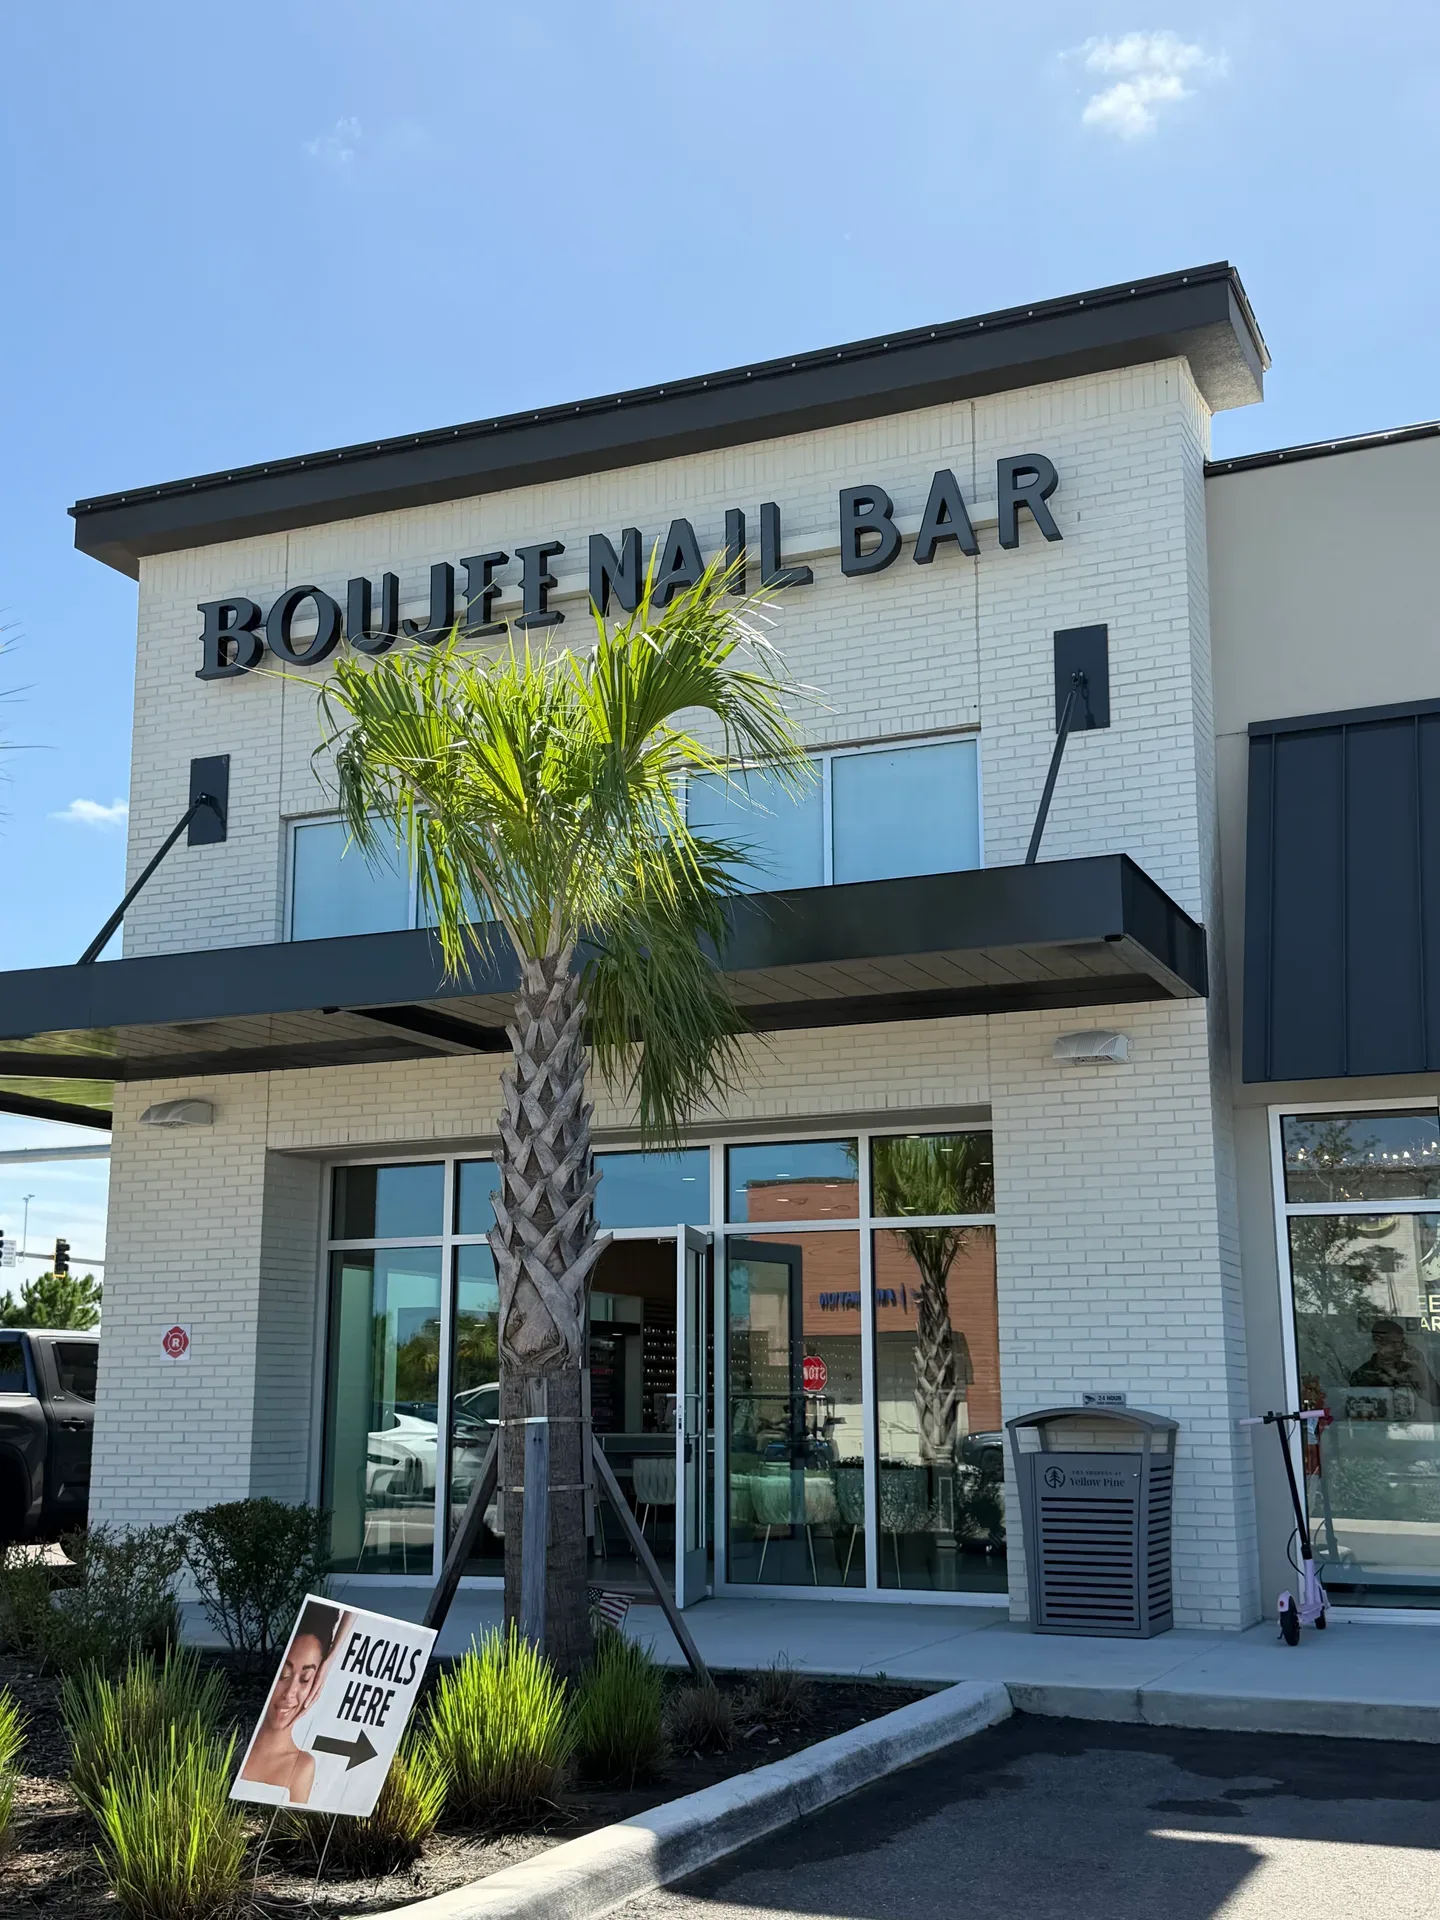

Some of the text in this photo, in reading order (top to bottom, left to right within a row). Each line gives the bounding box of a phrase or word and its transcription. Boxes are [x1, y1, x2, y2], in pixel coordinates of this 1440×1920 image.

[196, 453, 1064, 681] BOUJEE NAIL BAR
[172, 1338, 180, 1347] R
[1069, 1477, 1125, 1487] Yellow Pine
[340, 1632, 423, 1685] FACIALS
[336, 1681, 396, 1727] HERE
